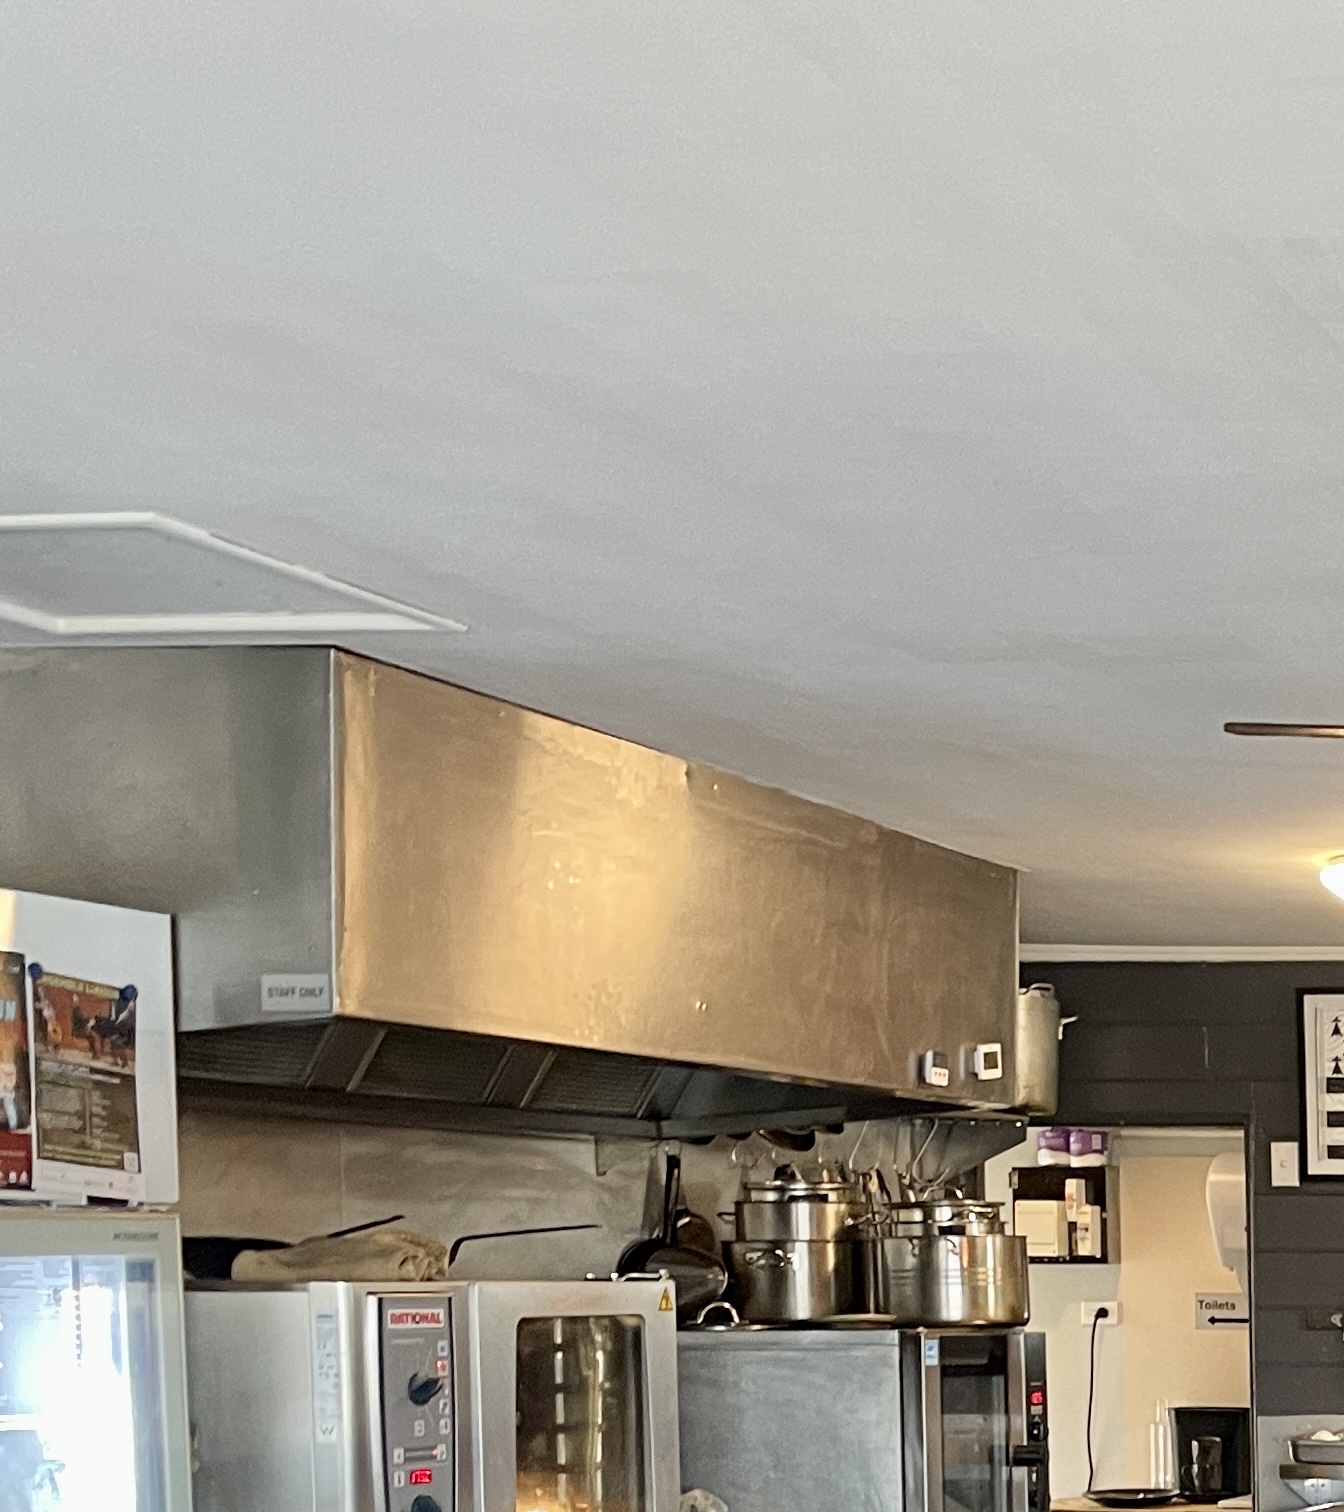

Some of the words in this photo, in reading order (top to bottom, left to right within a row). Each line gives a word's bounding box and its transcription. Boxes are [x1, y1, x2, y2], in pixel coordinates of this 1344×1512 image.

[266, 986, 296, 999] STAFF
[299, 986, 325, 998] ONLY
[1197, 1299, 1236, 1311] Toilets
[390, 1312, 443, 1325] RATIONAL
